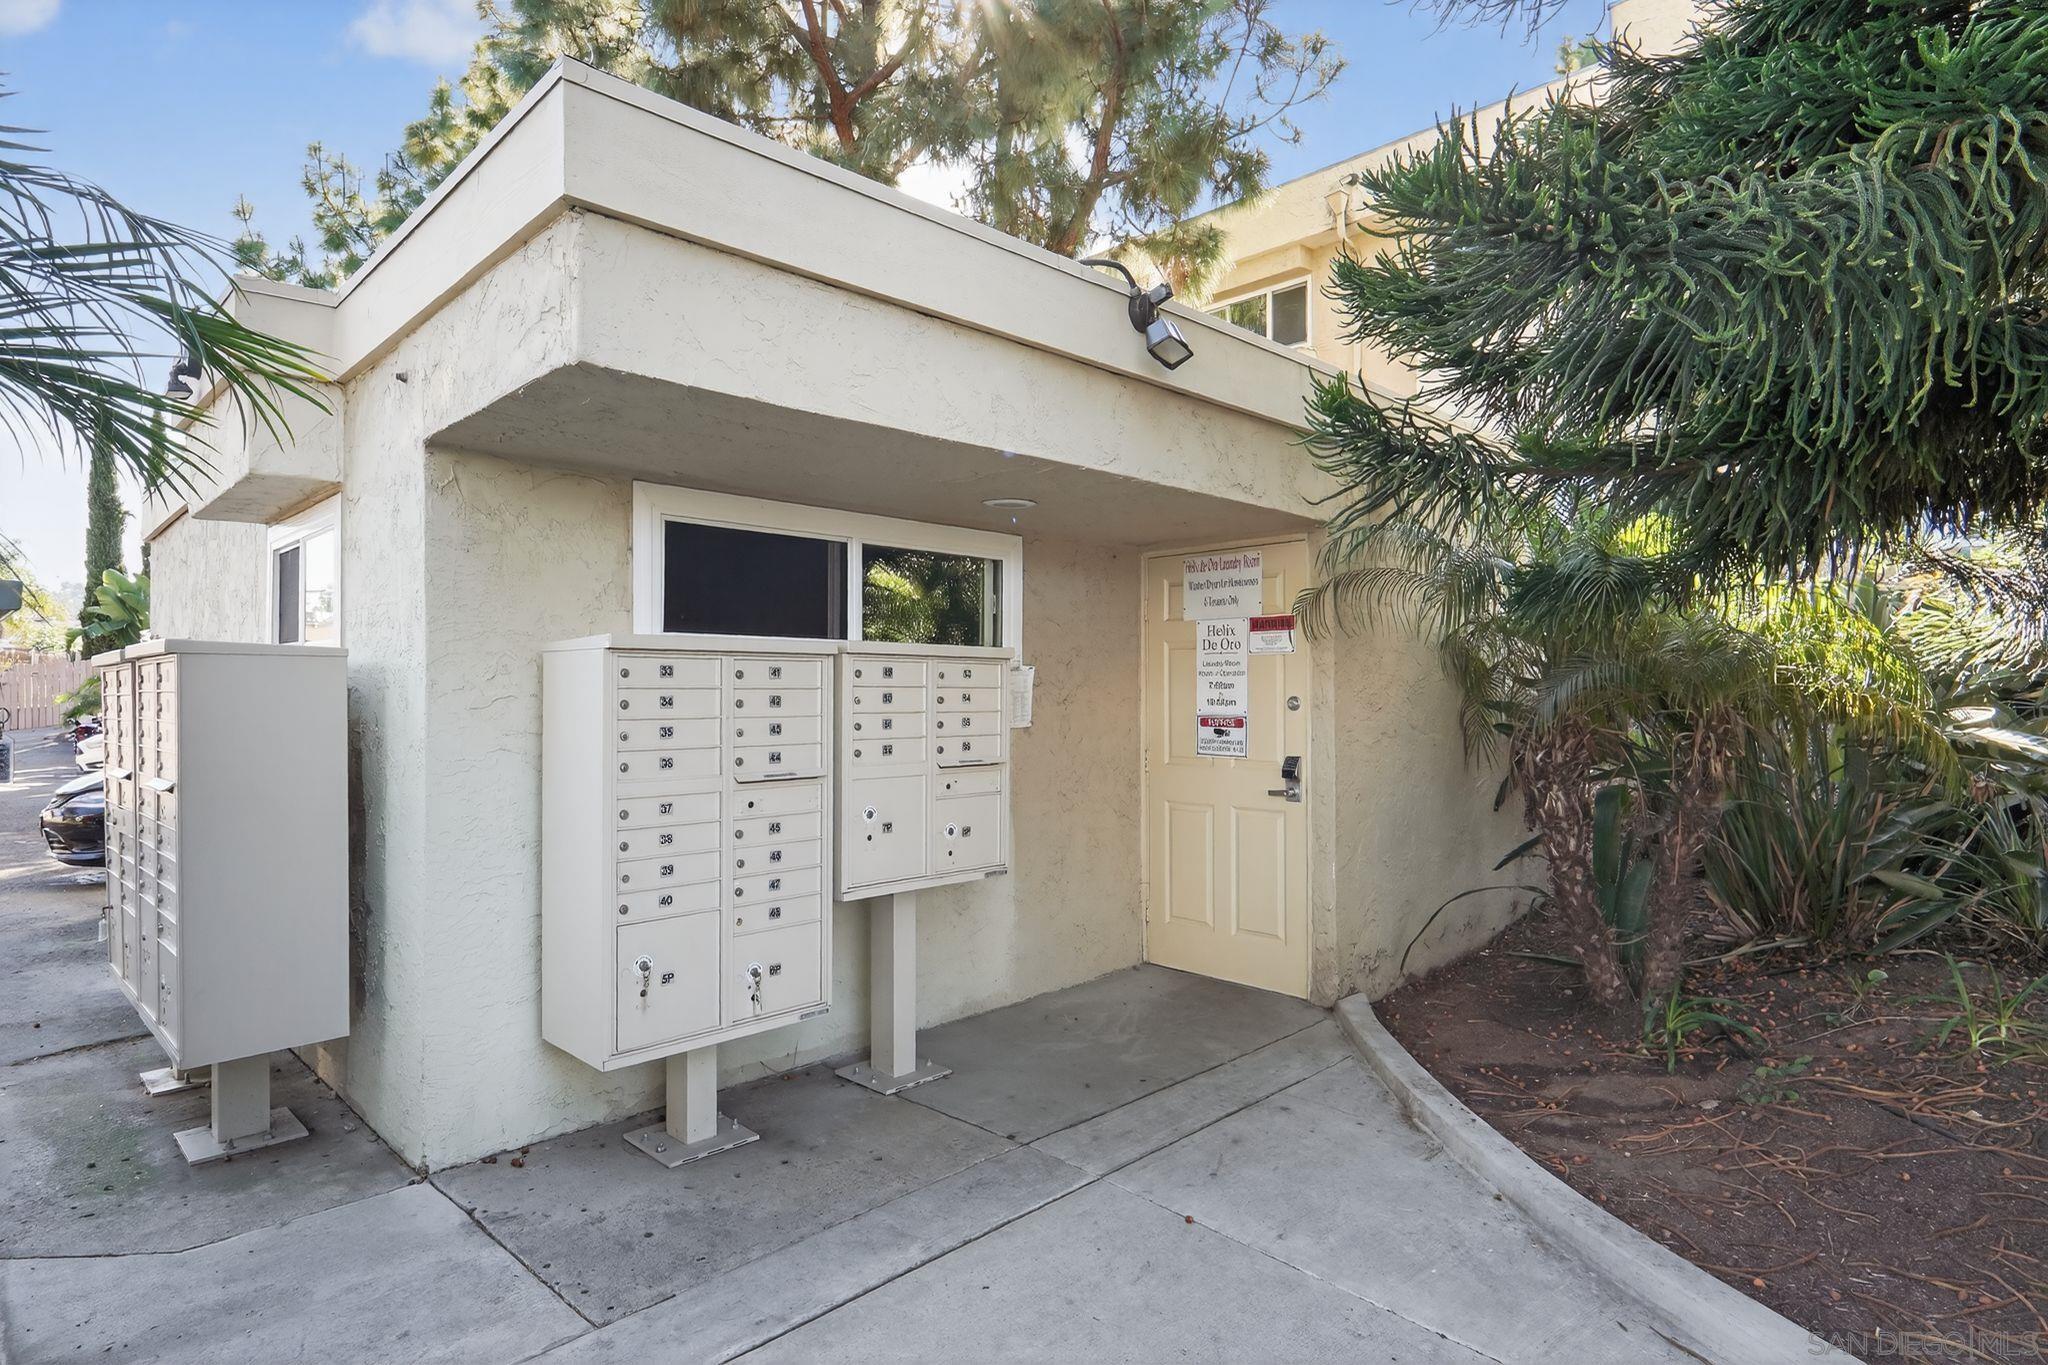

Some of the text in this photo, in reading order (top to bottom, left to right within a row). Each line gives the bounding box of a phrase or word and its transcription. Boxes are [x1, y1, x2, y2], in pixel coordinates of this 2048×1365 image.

[1207, 624, 1236, 637] Helix
[1203, 638, 1241, 651] De Oro
[660, 803, 672, 813] 37
[659, 895, 672, 905] 40
[662, 973, 674, 984] 5P
